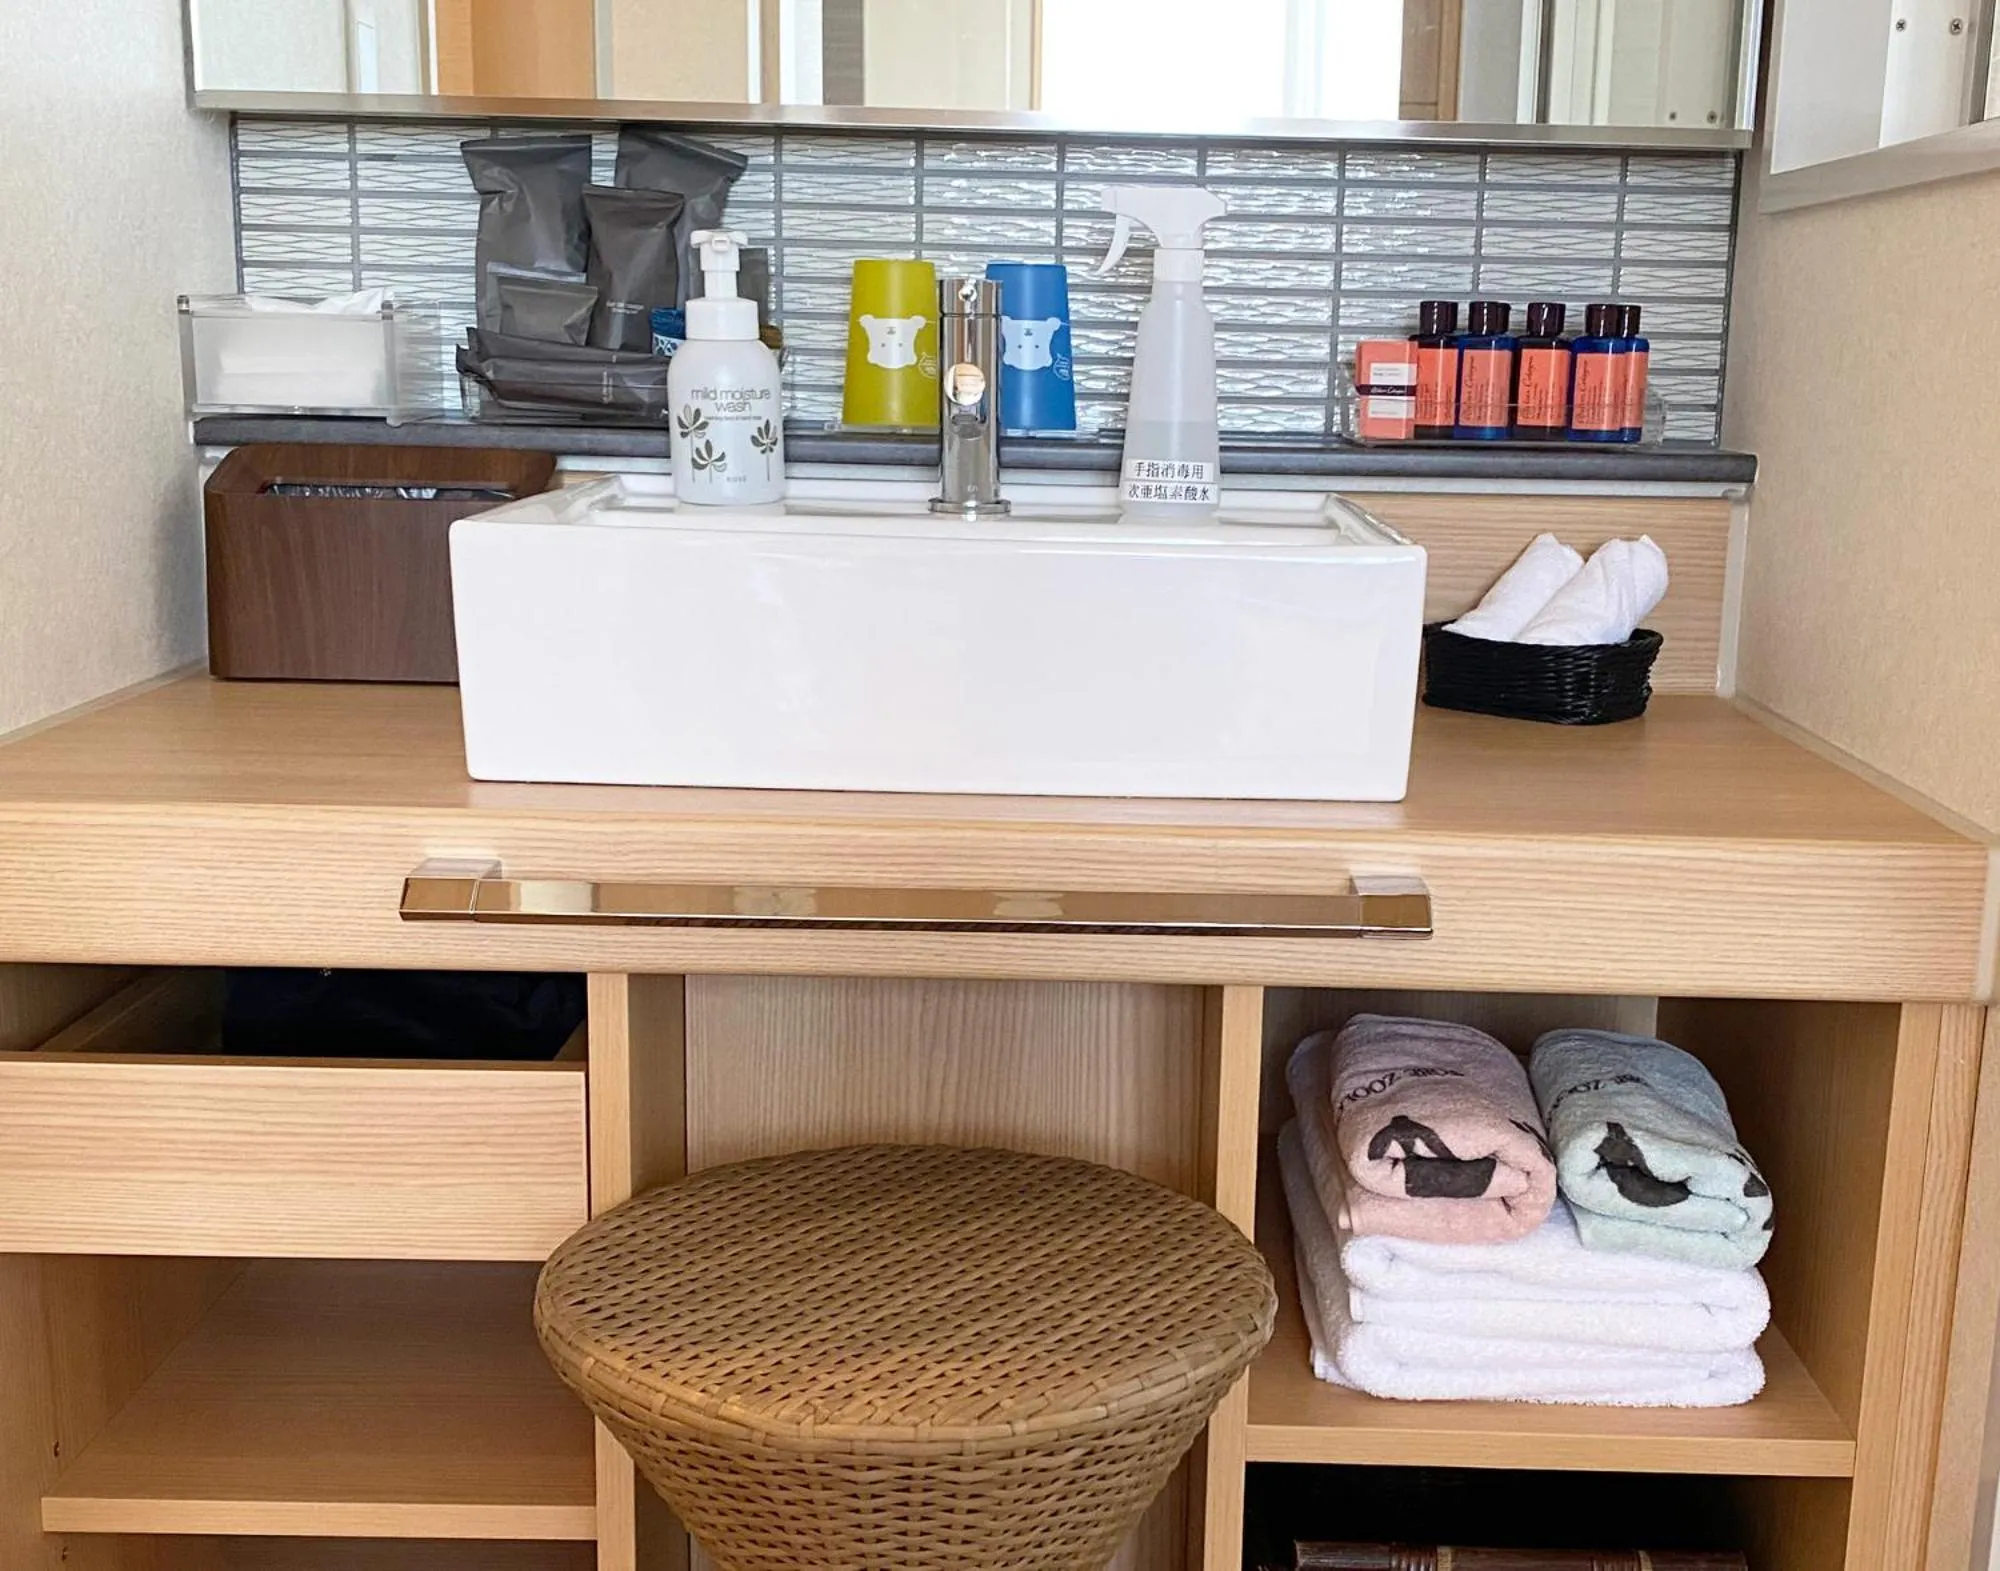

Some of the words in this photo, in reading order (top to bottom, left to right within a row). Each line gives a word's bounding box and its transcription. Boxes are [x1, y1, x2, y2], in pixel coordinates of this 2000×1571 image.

[691, 387, 717, 400] mild
[720, 386, 771, 400] moisture
[715, 402, 752, 413] wash
[1134, 462, 1204, 479] 手指消毒用
[1128, 483, 1210, 501] 次亜塩素酸水
